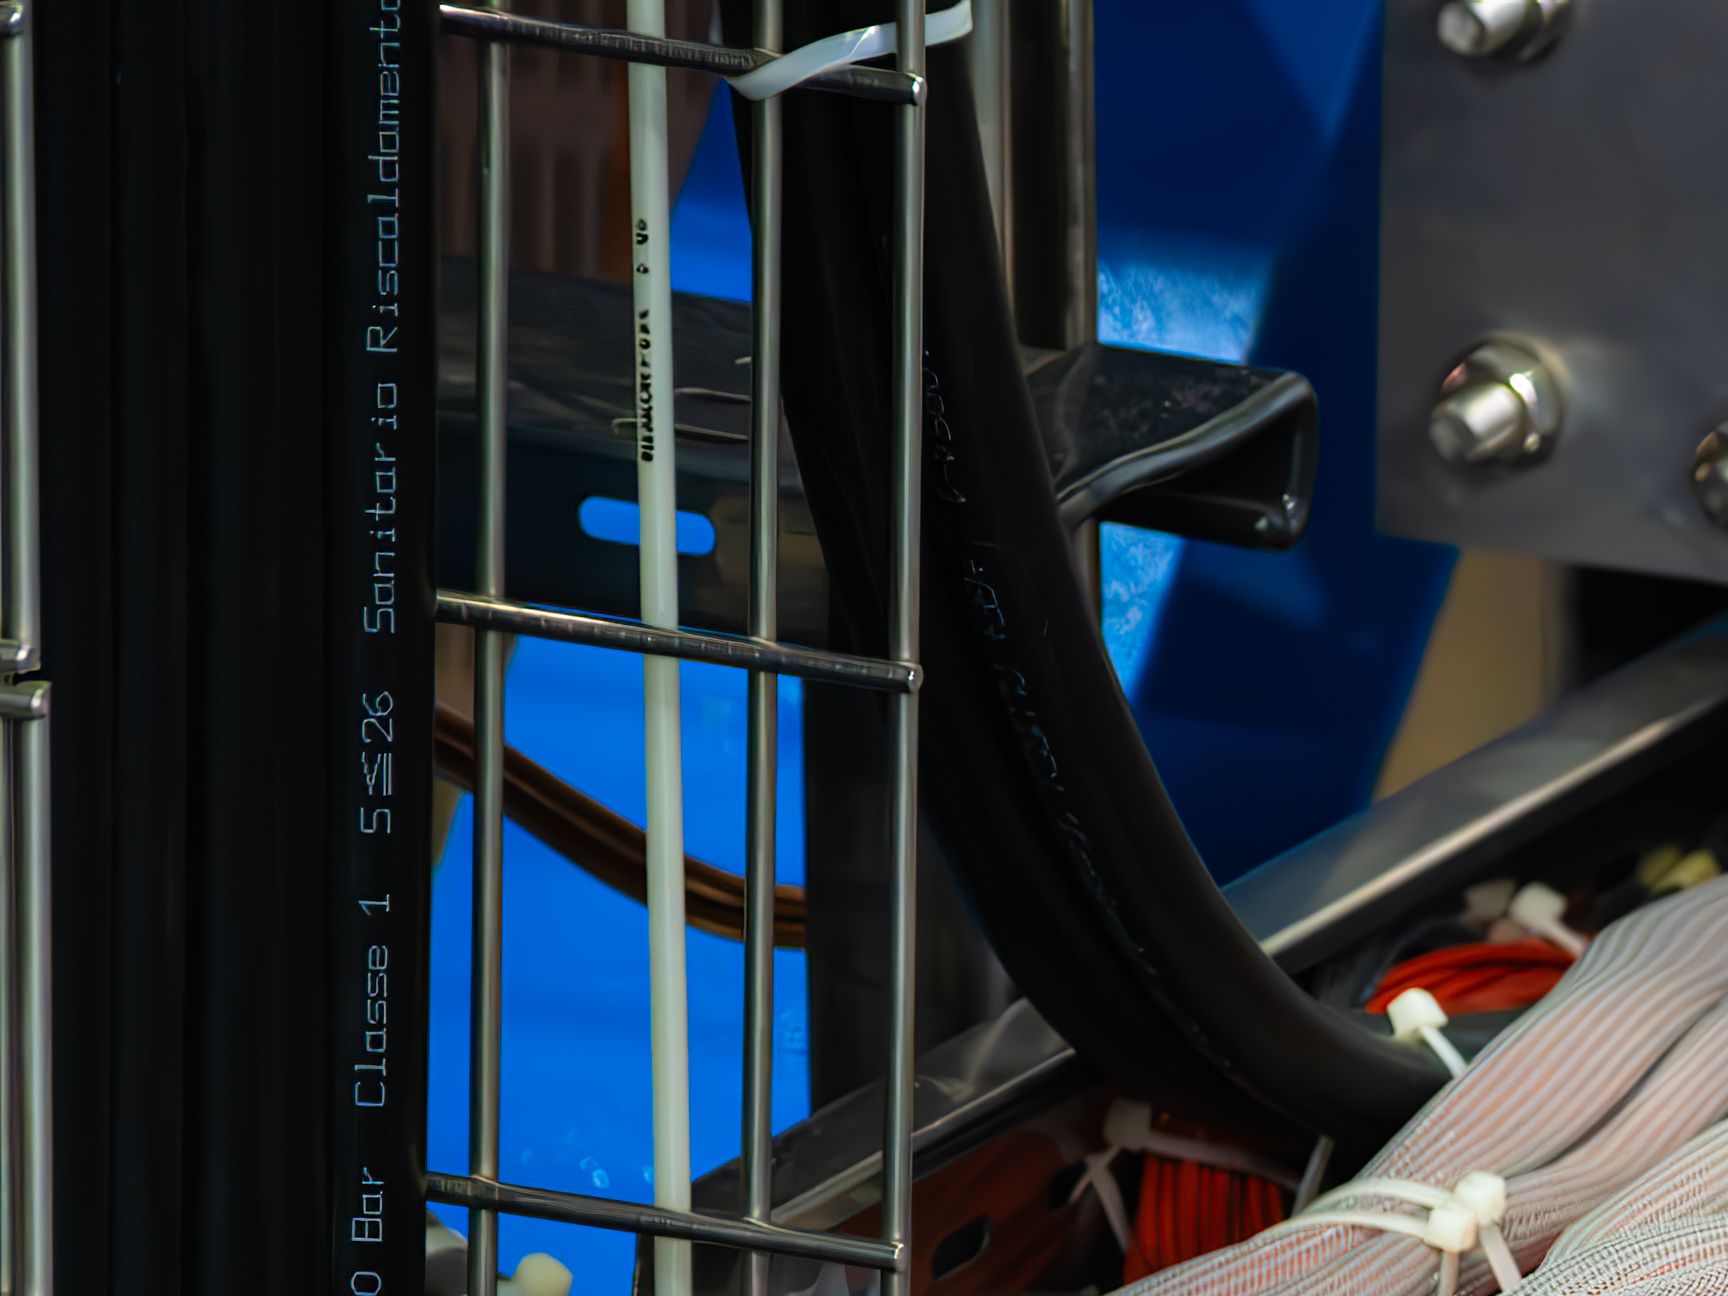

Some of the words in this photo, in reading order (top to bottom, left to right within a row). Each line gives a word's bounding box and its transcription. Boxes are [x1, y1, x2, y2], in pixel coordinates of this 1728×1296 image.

[363, 383, 398, 634] Sanitario
[358, 894, 390, 915] 1
[353, 945, 388, 1107] Classe
[351, 1167, 384, 1242] Bar
